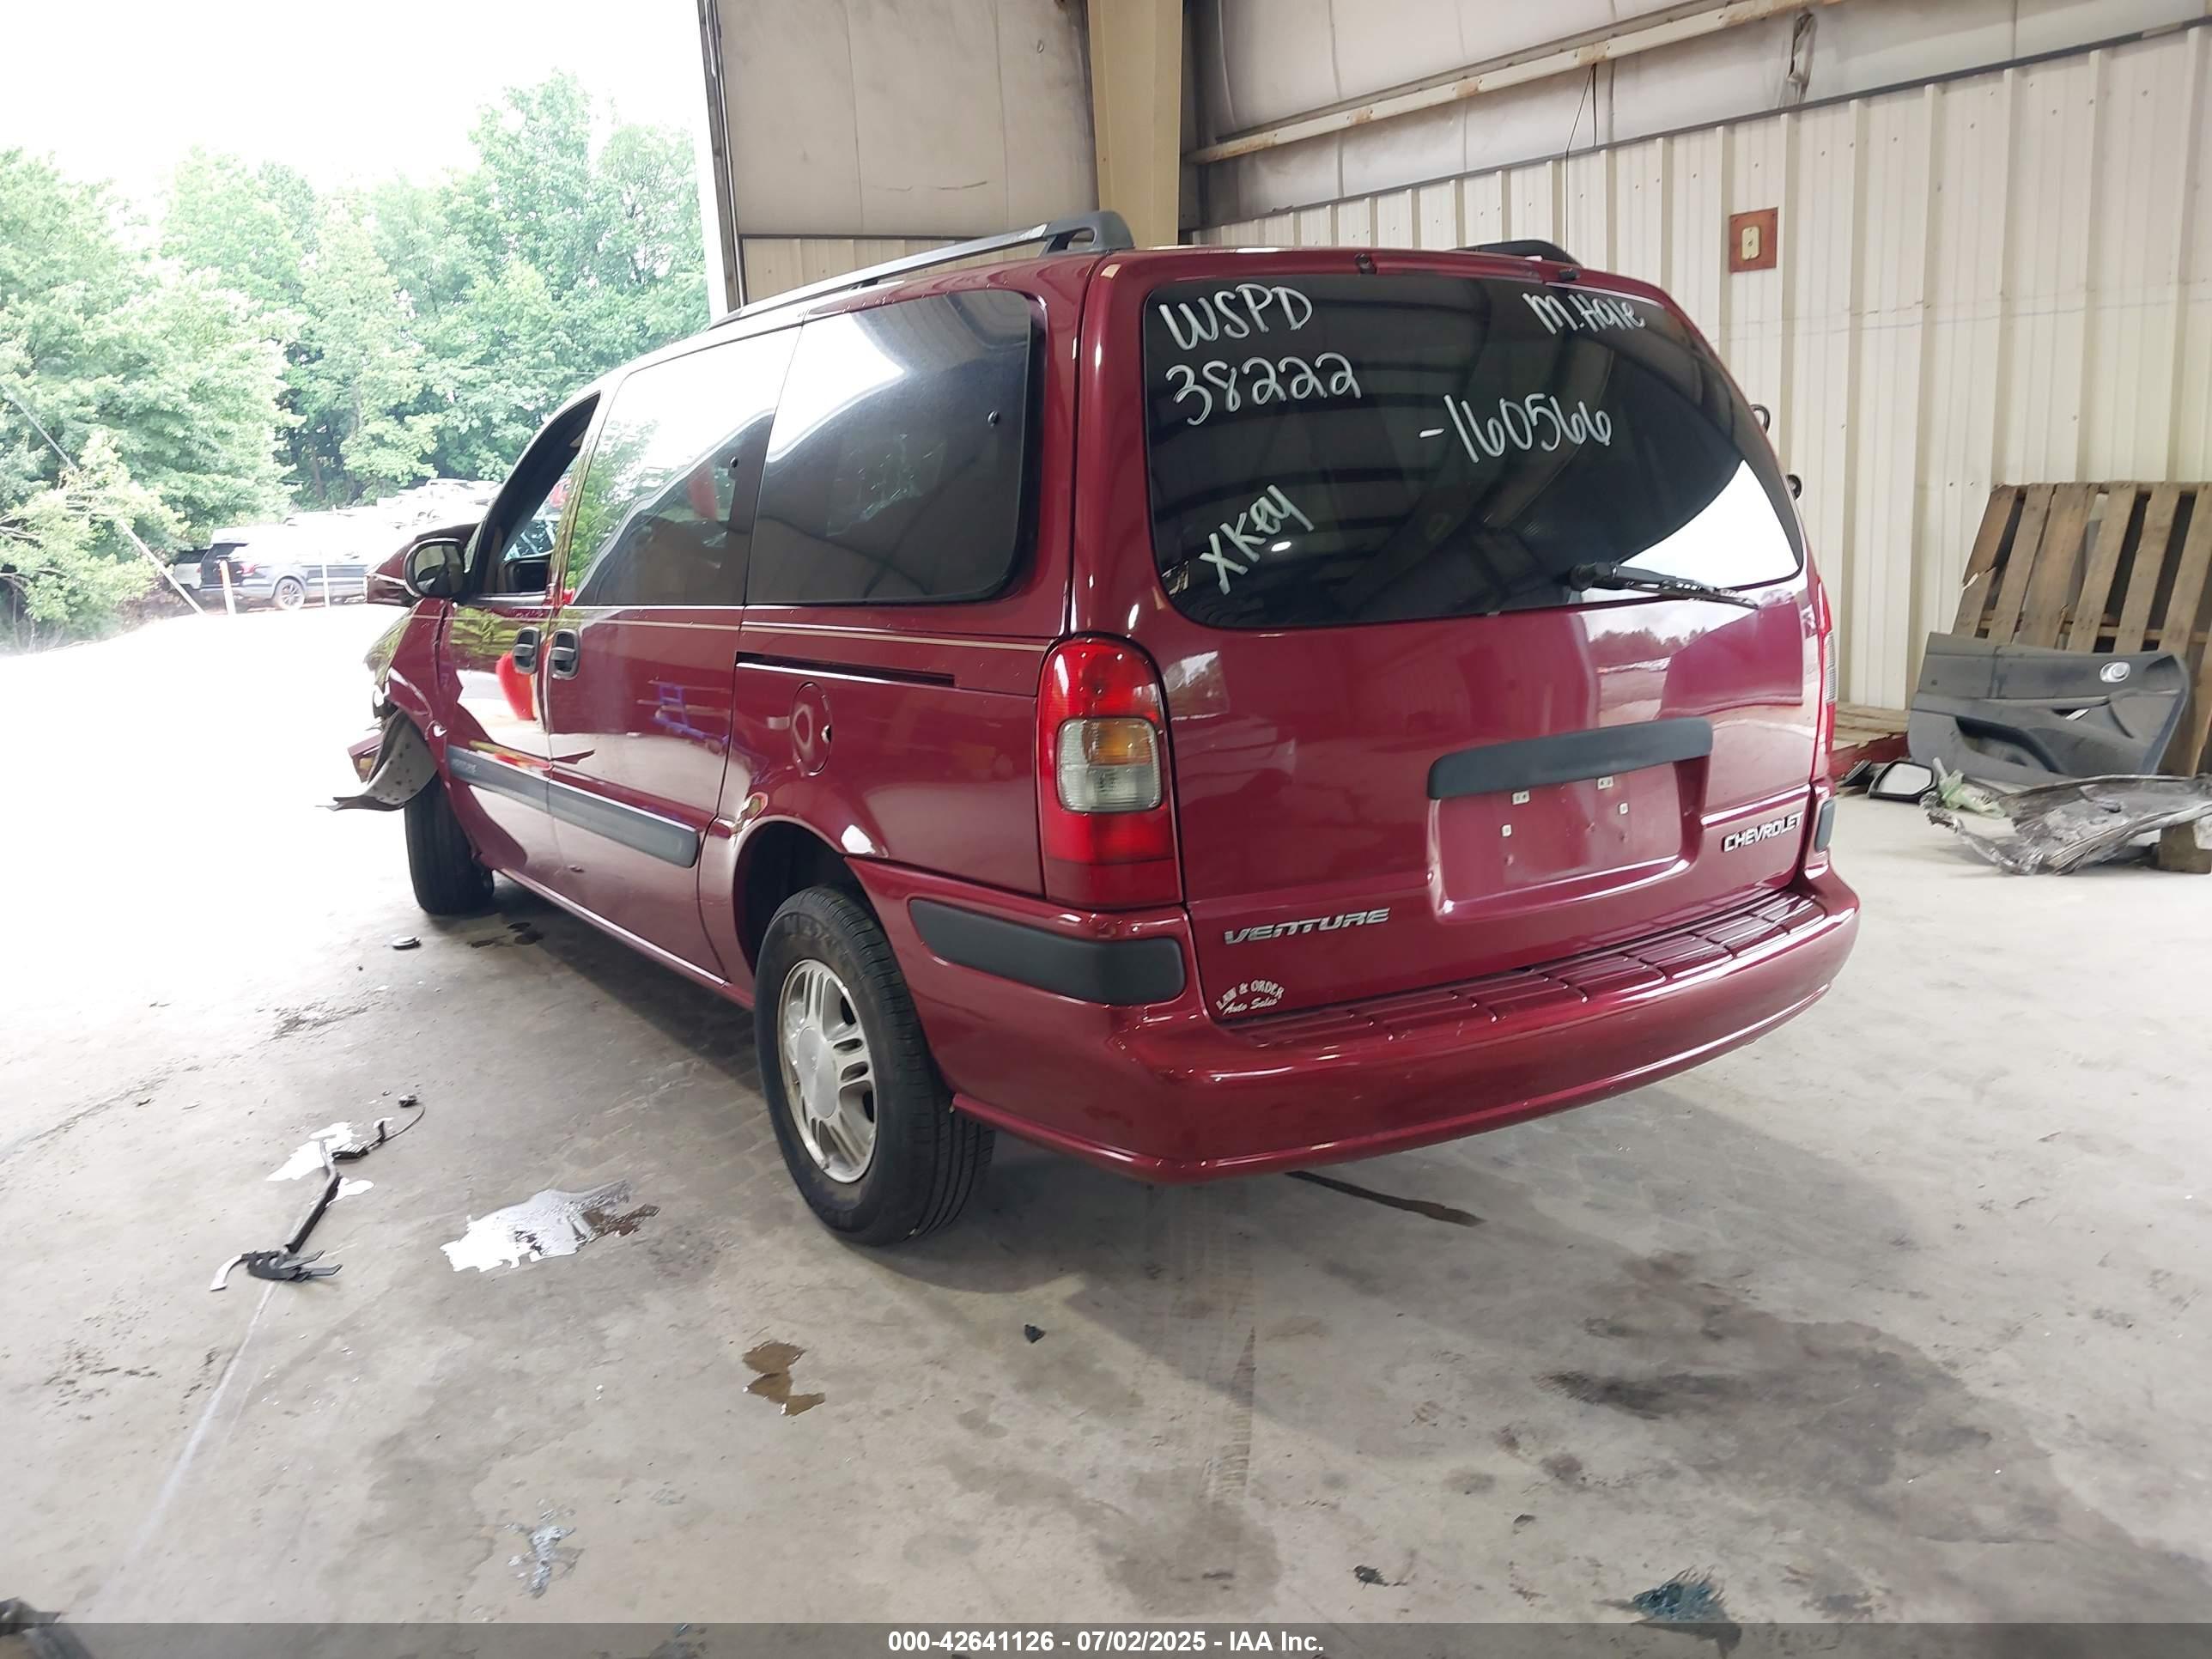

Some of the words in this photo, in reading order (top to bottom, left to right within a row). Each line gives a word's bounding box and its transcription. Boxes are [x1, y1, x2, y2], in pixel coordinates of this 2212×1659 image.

[1158, 283, 1313, 350] WSPD
[1165, 352, 1362, 425] 38222
[1722, 811, 1803, 852] CHEVROLET
[1224, 907, 1390, 945] VENTURE
[1250, 979, 1285, 1000] ORDER
